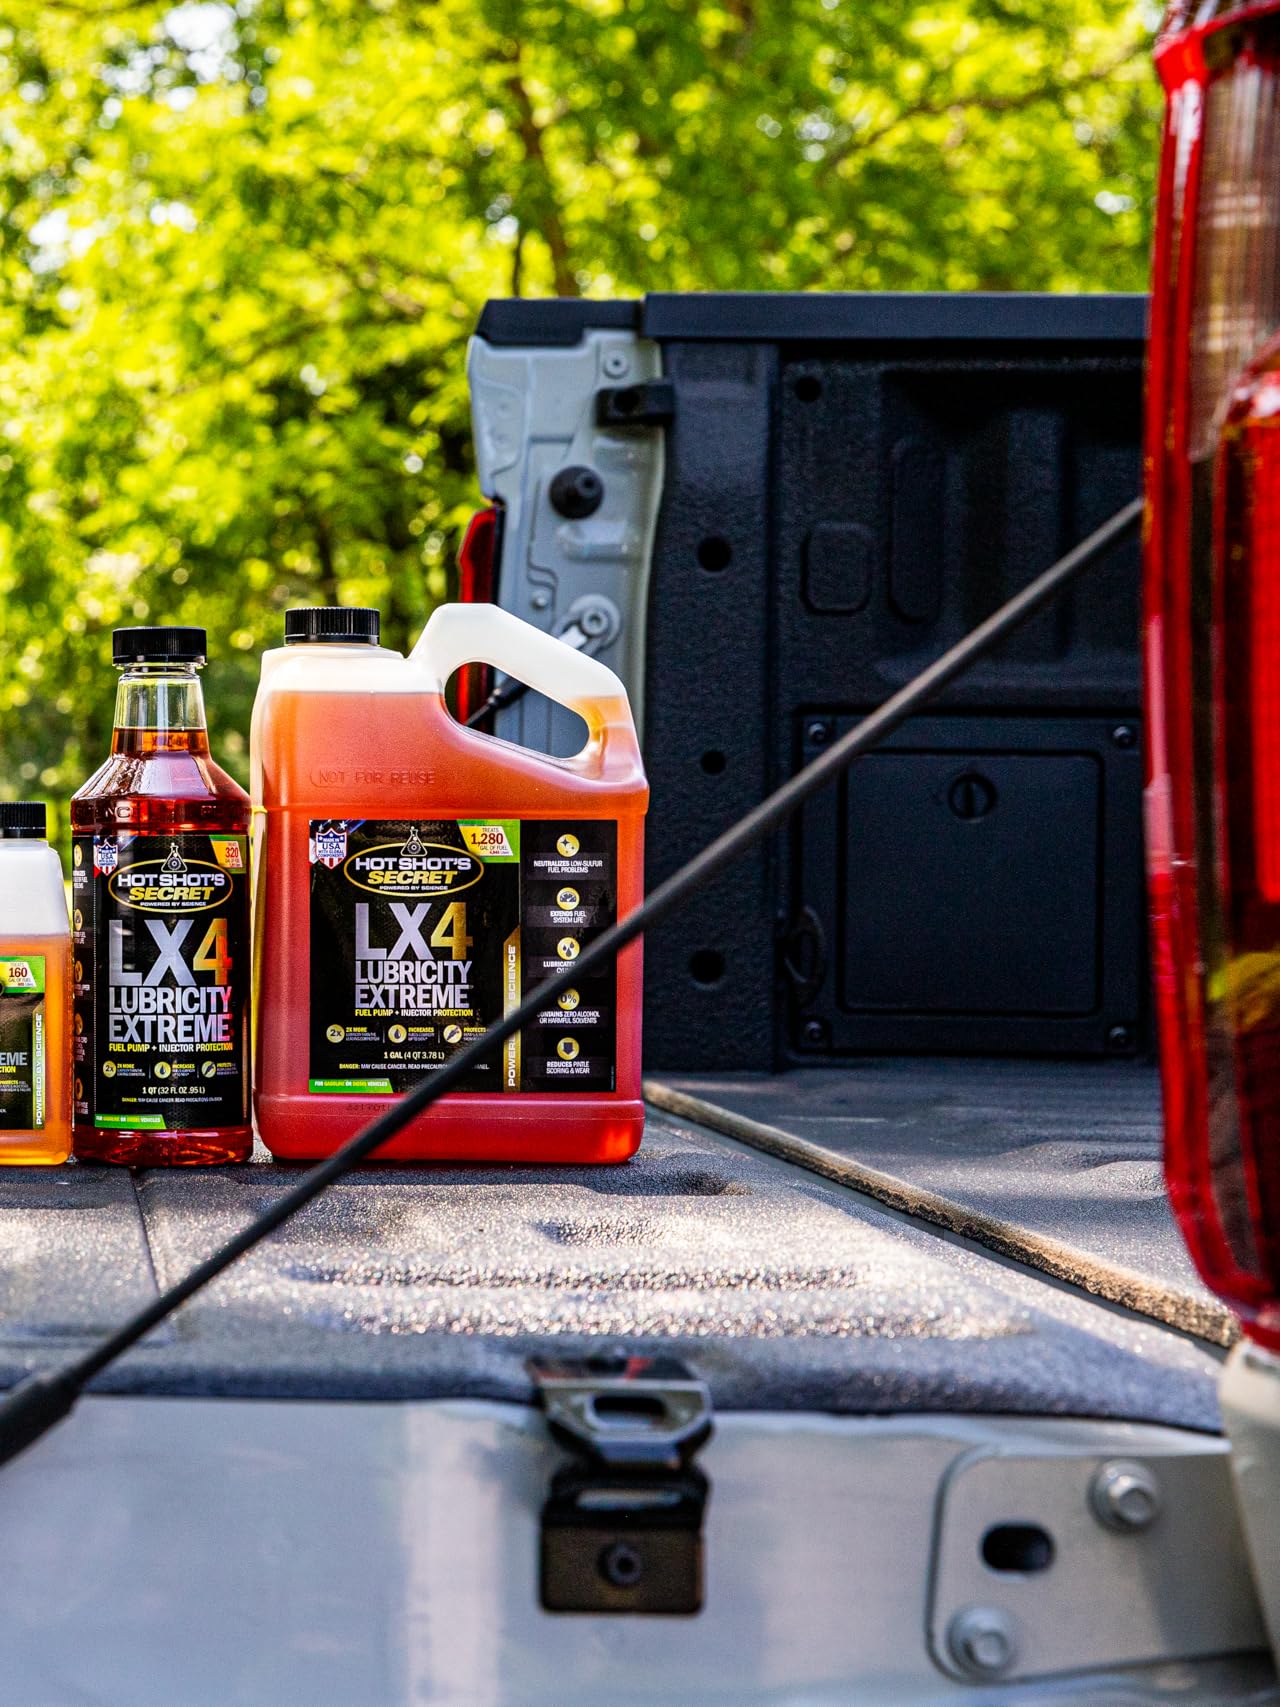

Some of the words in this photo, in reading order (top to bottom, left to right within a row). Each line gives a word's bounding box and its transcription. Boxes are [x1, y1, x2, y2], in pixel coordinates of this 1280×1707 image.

[320, 770, 344, 784] NOT
[356, 770, 383, 784] FOR
[391, 770, 435, 784] REUSE
[322, 842, 340, 850] USA
[471, 832, 503, 847] 1,280
[225, 847, 238, 858] 320
[355, 857, 398, 870] HOT
[399, 857, 471, 870] SHOT'S
[118, 874, 158, 887] HOT
[159, 874, 225, 887] SHOT'S
[368, 870, 458, 885] SECRET
[128, 887, 215, 901] SECRET
[355, 902, 473, 960] LX4
[109, 918, 232, 986] LX4
[9, 967, 27, 977] 160
[355, 960, 472, 984] LUBRICITY
[508, 945, 516, 1000] SCIENCE
[109, 986, 232, 1014] LUBRICITY
[355, 984, 470, 1008] EXTREME
[560, 994, 577, 1004] 0%
[355, 1008, 372, 1017] FUEL
[373, 1008, 393, 1017] PUMP
[401, 1008, 431, 1017] INJECTOR
[433, 1008, 473, 1017] PROTECTION
[109, 1014, 231, 1043] EXTREME
[109, 1043, 126, 1052] FUEL
[127, 1043, 149, 1052] PUMP
[159, 1043, 194, 1052] INJECTOR
[196, 1043, 233, 1052] PROTECTION
[384, 1051, 388, 1060] 1
[390, 1051, 403, 1060] GAL
[404, 1051, 411, 1060] (4
[412, 1051, 421, 1060] QT
[422, 1051, 437, 1060] 3.78
[438, 1051, 445, 1060] L)
[36, 1060, 42, 1074] BY
[142, 1086, 147, 1094] 1
[148, 1086, 157, 1094] QT
[158, 1086, 169, 1094] (32
[170, 1086, 177, 1094] FL
[179, 1086, 187, 1094] OZ
